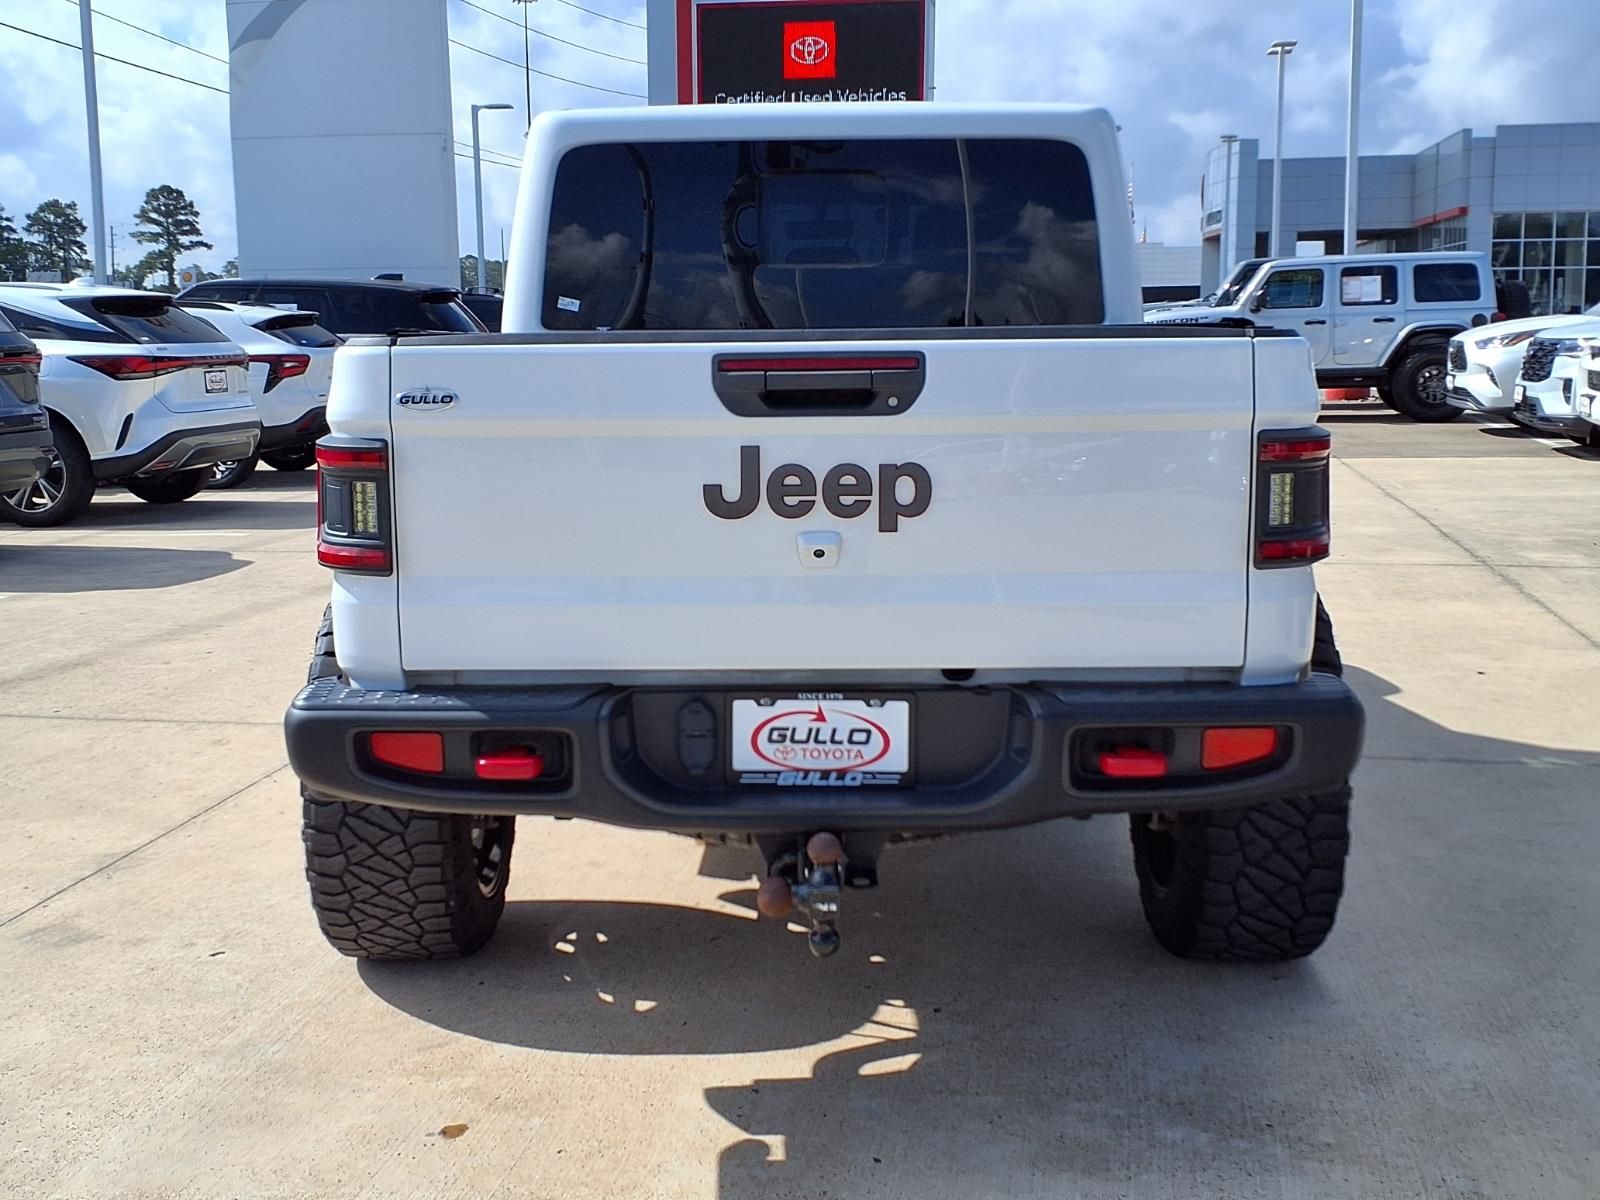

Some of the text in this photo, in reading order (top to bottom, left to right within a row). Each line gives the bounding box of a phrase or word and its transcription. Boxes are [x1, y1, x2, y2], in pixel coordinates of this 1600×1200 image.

[714, 88, 906, 104] Certified Used Vehicles
[399, 395, 454, 405] GULLO
[703, 445, 932, 532] Jeep
[798, 692, 824, 700] SINCE
[767, 726, 872, 745] GULLO
[800, 748, 865, 760] TOYOTA
[776, 771, 865, 786] GULLO
